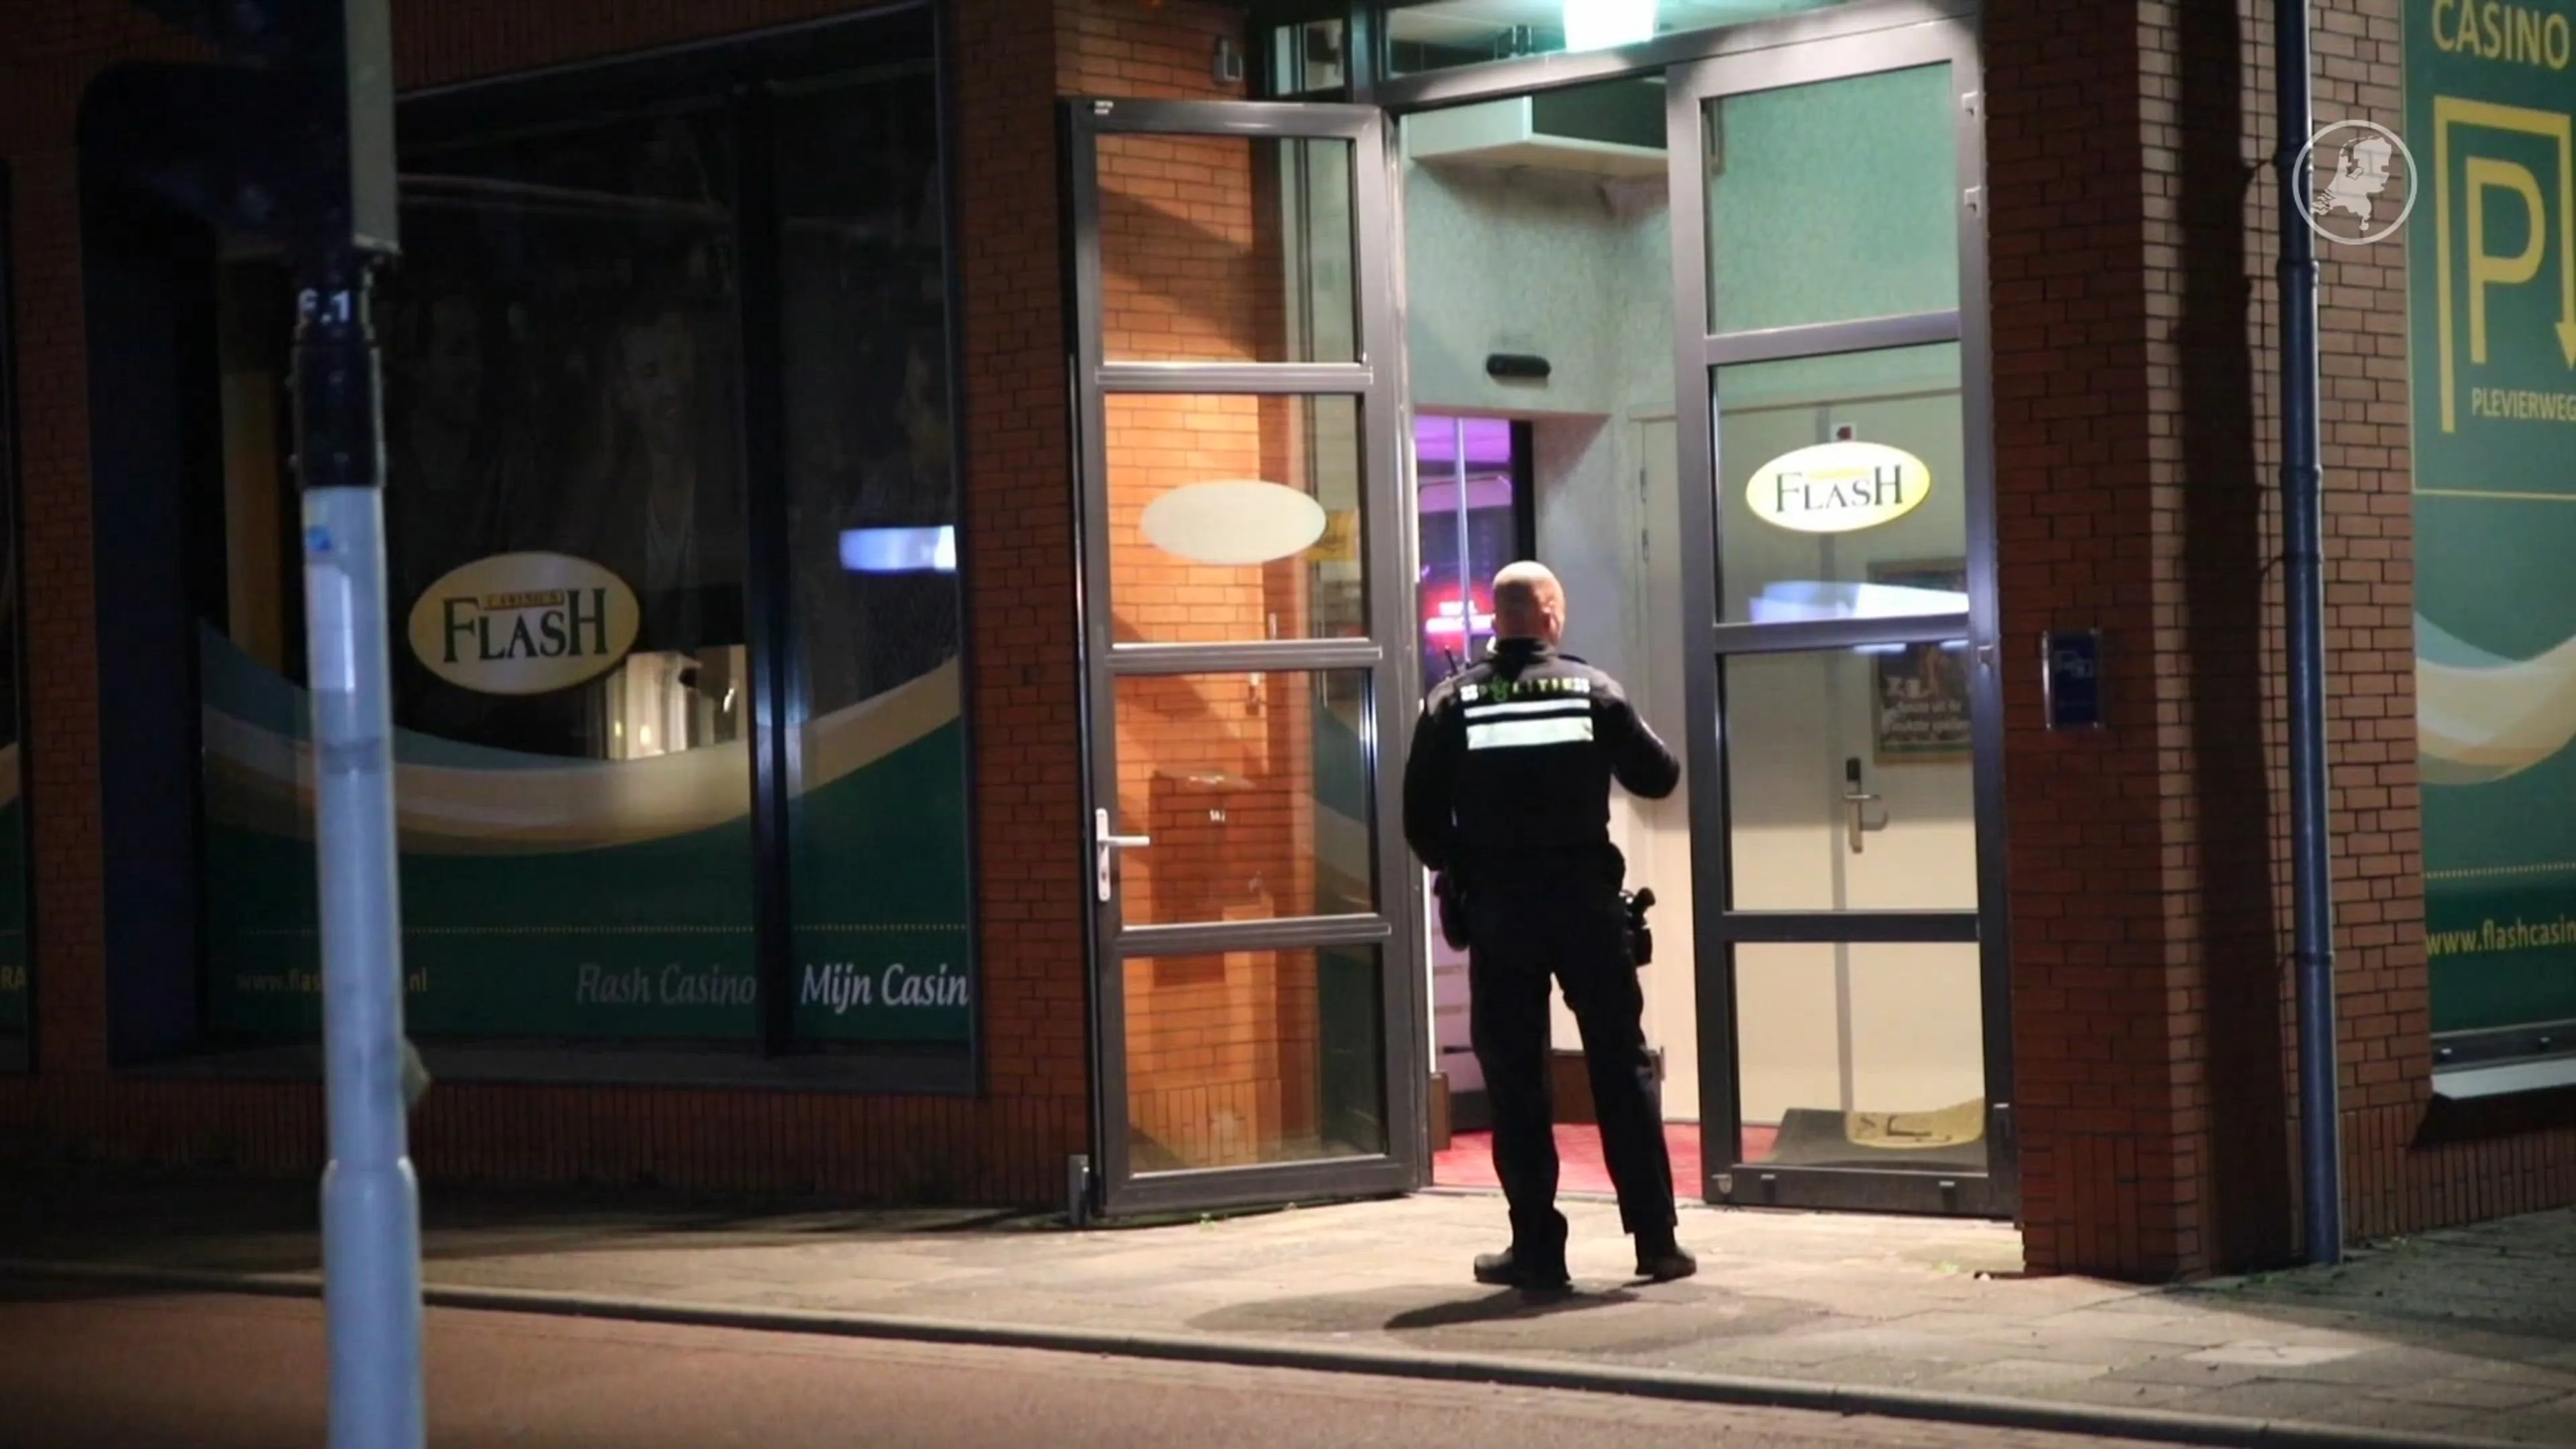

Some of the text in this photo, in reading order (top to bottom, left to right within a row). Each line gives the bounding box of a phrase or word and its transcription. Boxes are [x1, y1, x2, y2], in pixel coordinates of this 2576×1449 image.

[2432, 0, 2570, 69] CASINO
[2466, 156, 2546, 364] P
[2471, 387, 2576, 421] PLEVIERWEG
[1776, 464, 1902, 513] FLASH
[443, 588, 609, 663] FLASH
[576, 962, 651, 1006] Flash
[659, 962, 758, 1006] Casino
[800, 963, 873, 1014] Mijn
